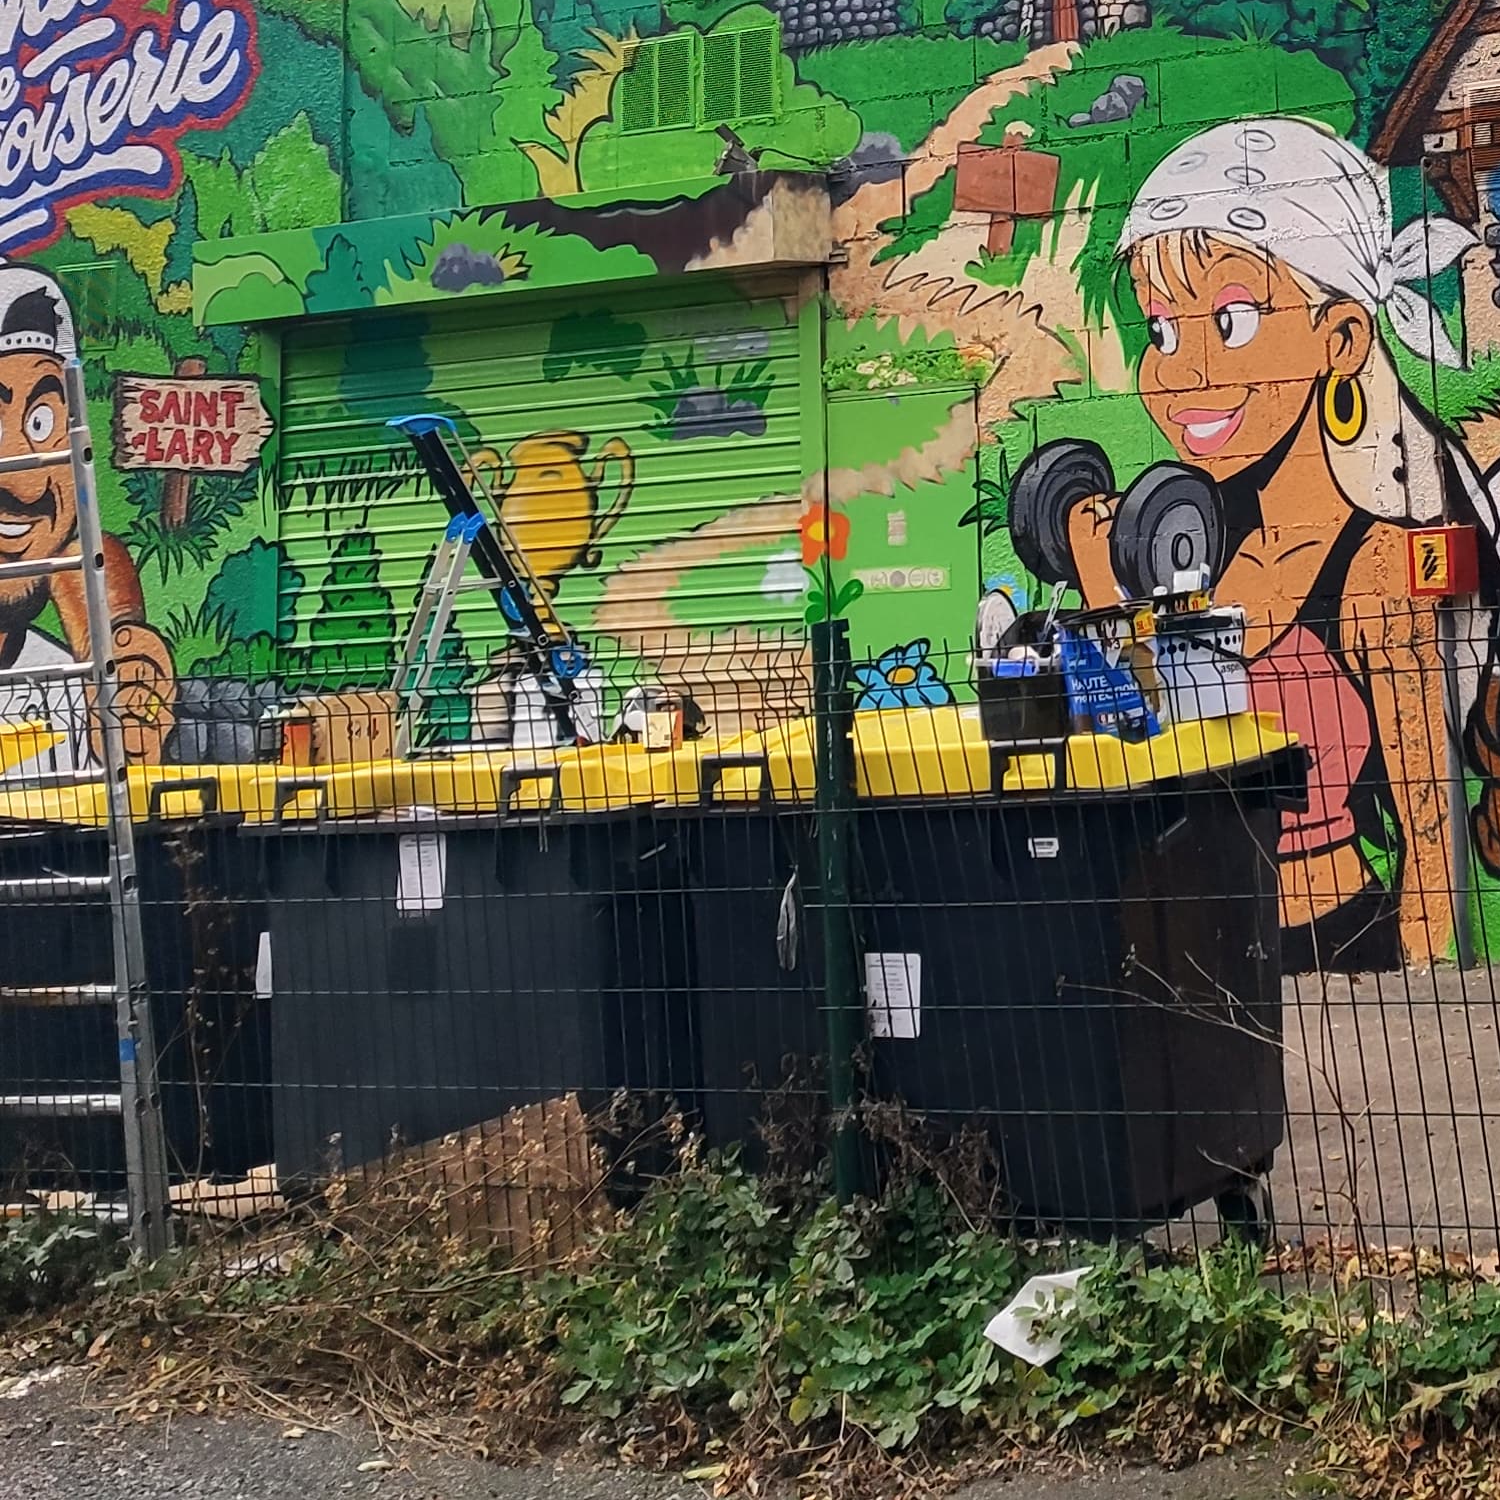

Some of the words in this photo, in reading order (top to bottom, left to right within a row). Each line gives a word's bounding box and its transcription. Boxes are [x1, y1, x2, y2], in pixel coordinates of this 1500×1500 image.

[0, 0, 241, 187] oiserie
[139, 389, 245, 428] SAINT
[1071, 675, 1109, 691] HAUTE
